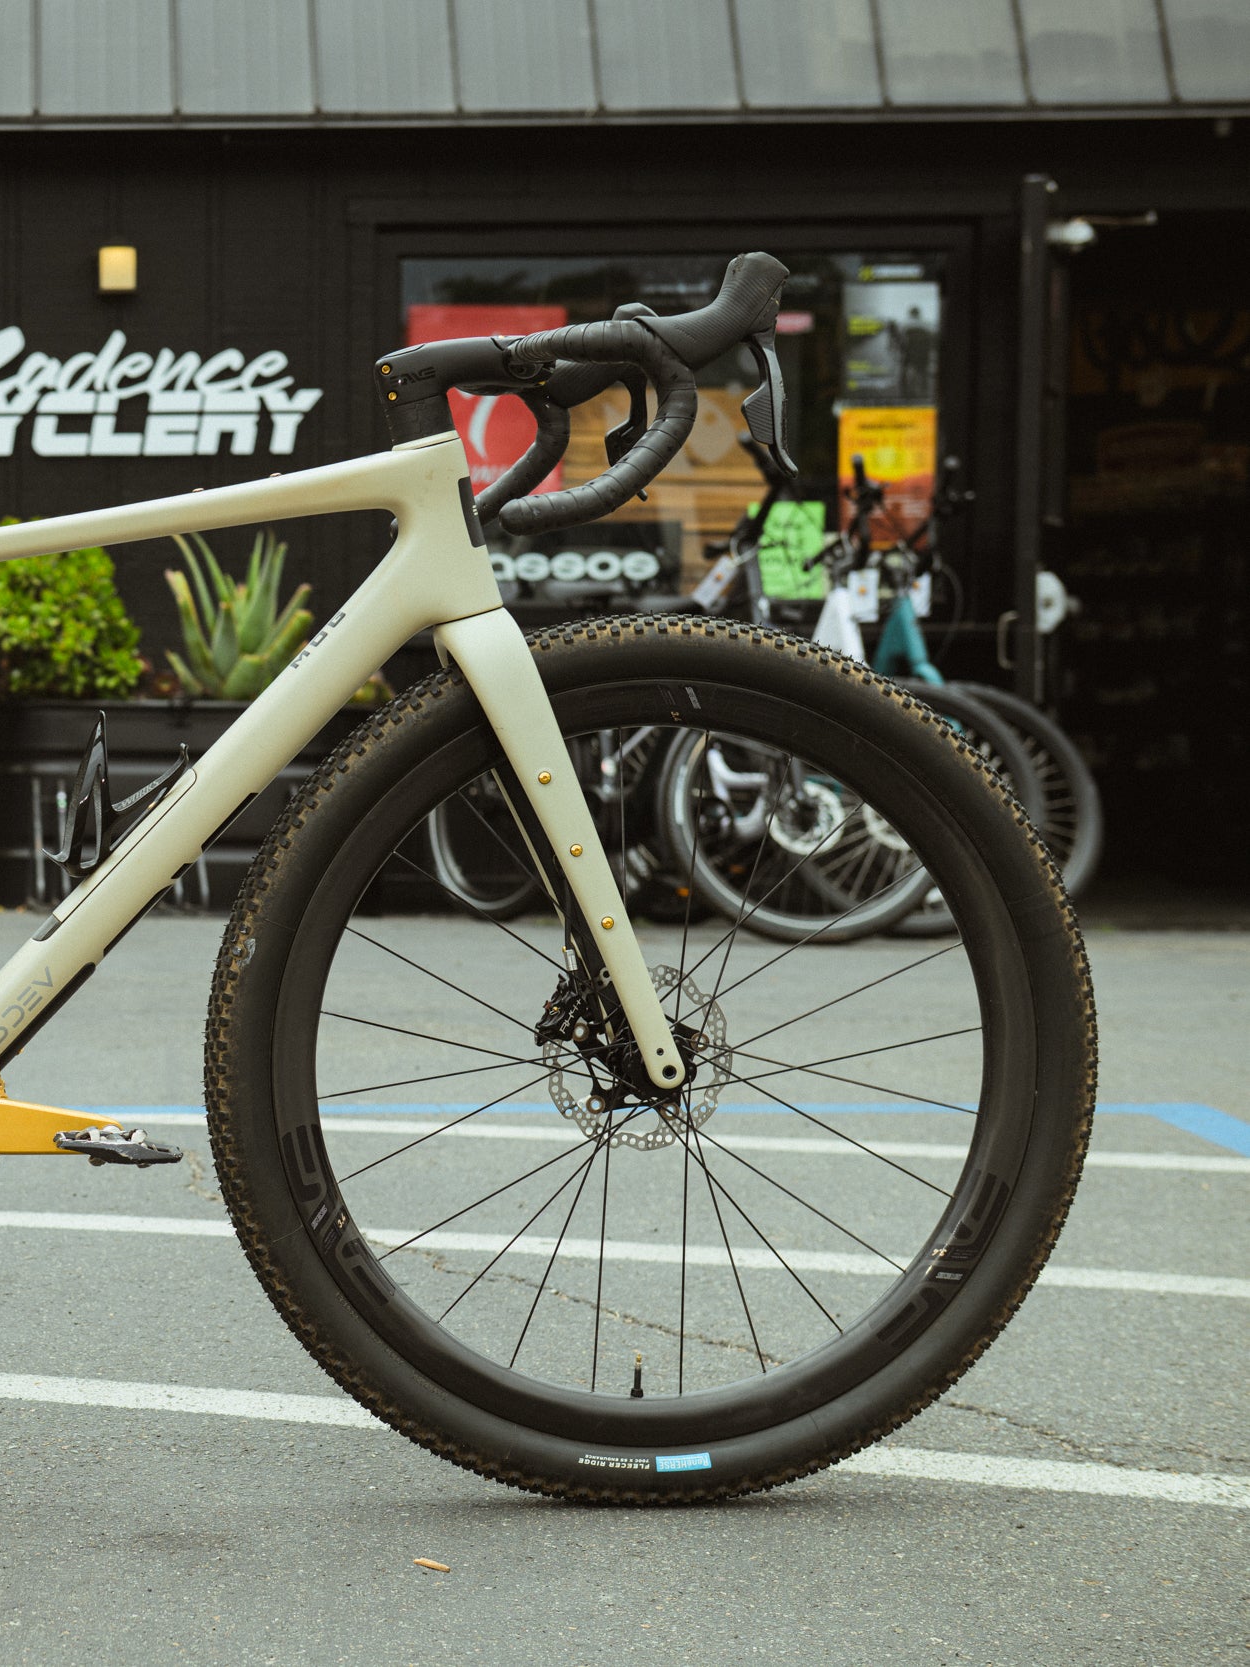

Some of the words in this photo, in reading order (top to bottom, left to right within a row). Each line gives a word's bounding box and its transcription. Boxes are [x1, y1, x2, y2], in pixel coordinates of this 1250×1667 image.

[290, 609, 346, 669] MOG
[578, 1457, 606, 1467] RIDGE
[608, 1462, 650, 1470] FLEECER
